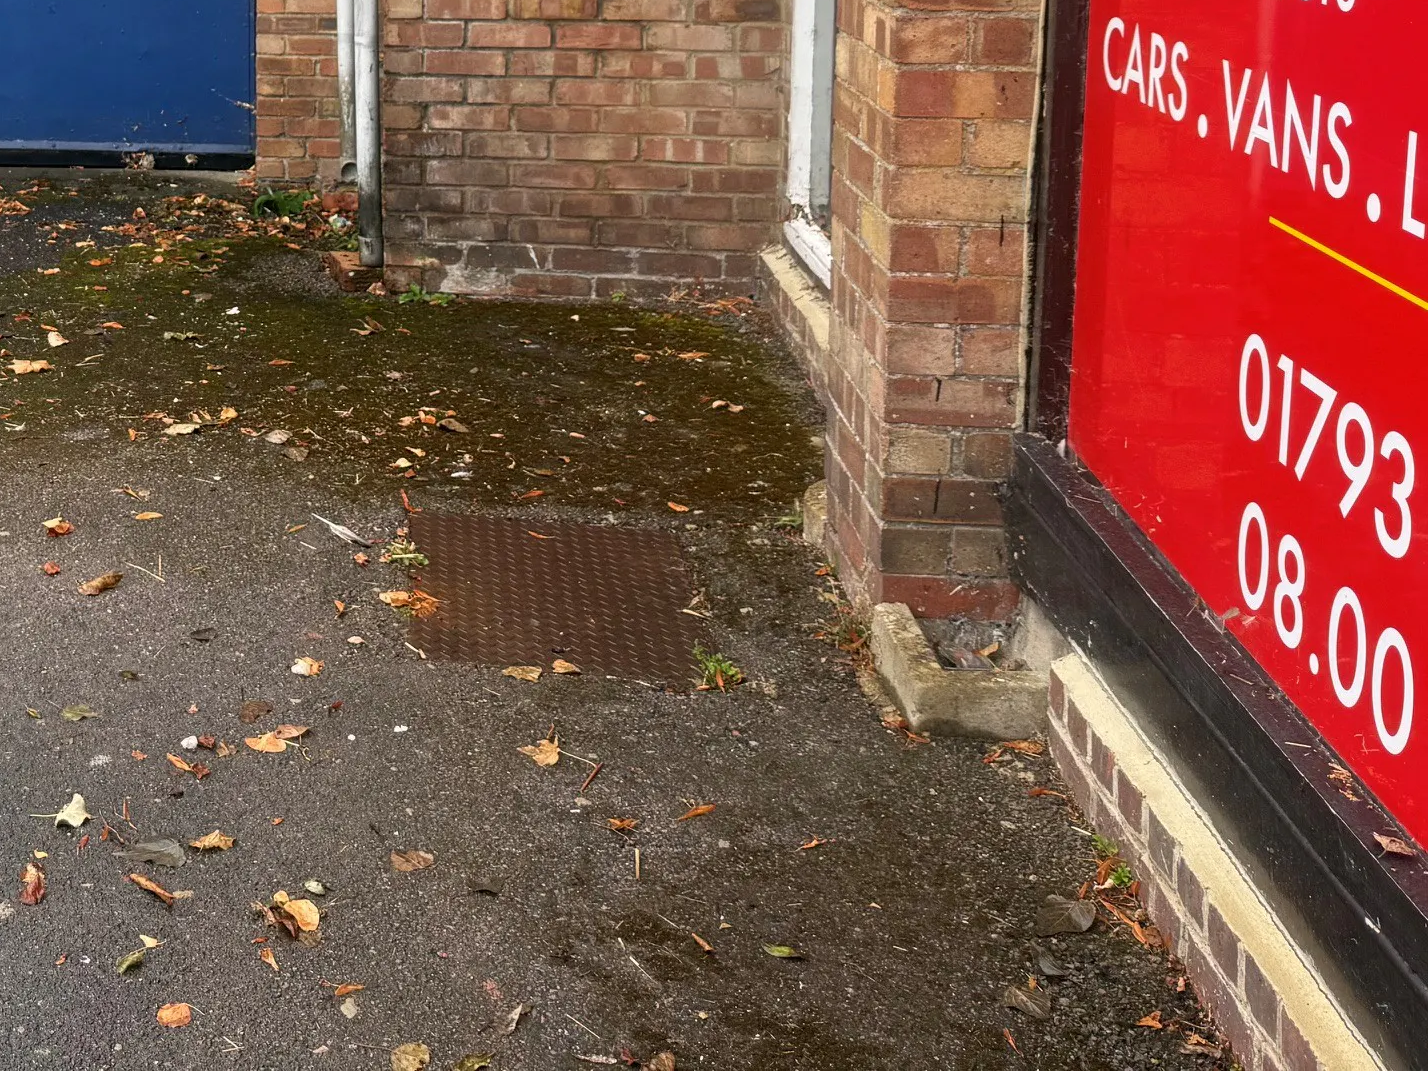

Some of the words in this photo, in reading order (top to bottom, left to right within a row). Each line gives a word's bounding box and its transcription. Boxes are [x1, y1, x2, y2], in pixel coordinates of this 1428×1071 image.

[1103, 17, 1188, 121] CARS
[1223, 60, 1352, 198] VANS
[1238, 334, 1414, 559] 01793
[1237, 502, 1414, 756] 08.00
